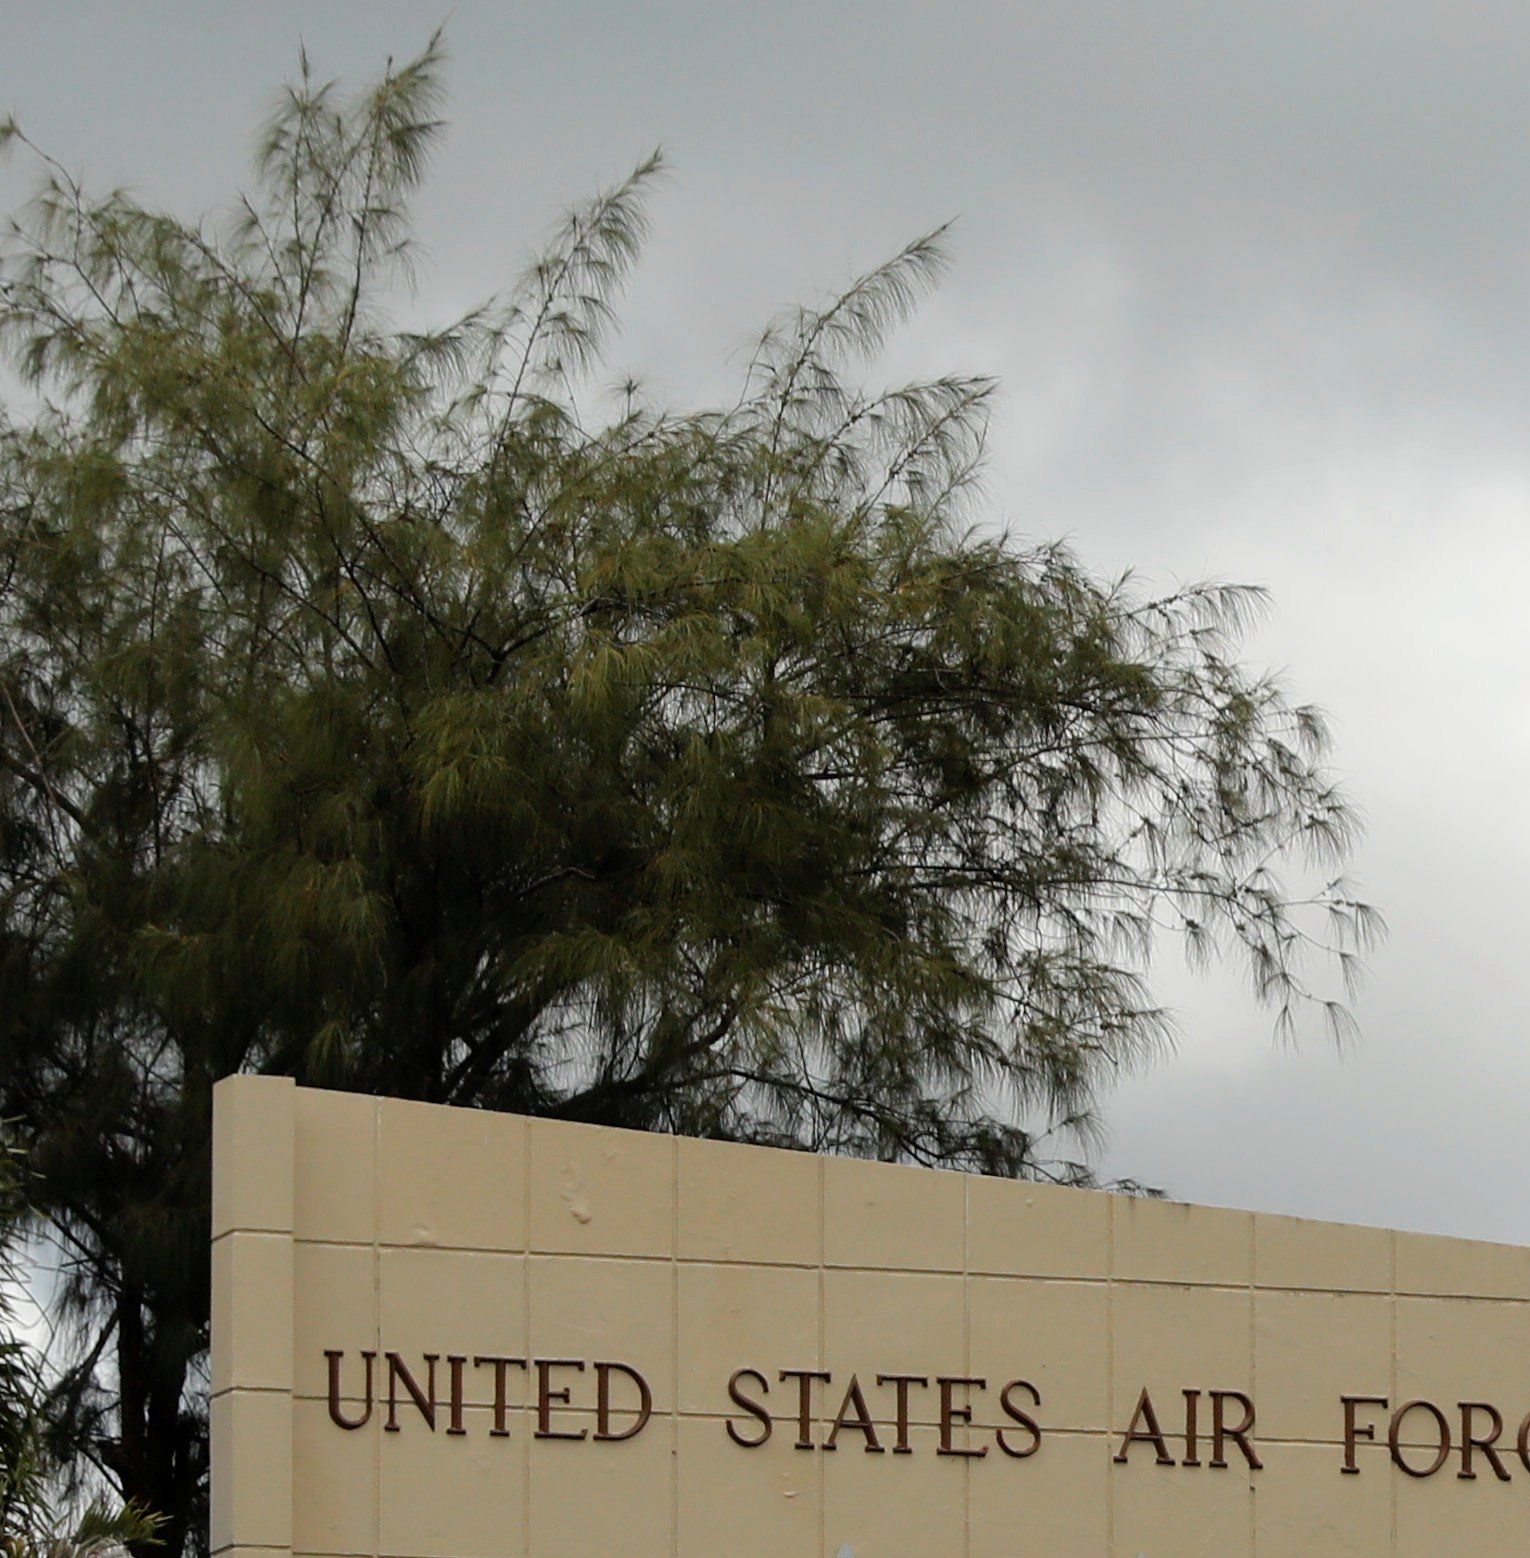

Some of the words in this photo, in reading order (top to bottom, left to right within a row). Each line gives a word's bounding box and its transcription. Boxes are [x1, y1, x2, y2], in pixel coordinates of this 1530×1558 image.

[323, 1350, 652, 1441] UNITED
[725, 1367, 1042, 1459] STATES
[1113, 1386, 1263, 1469] AIR
